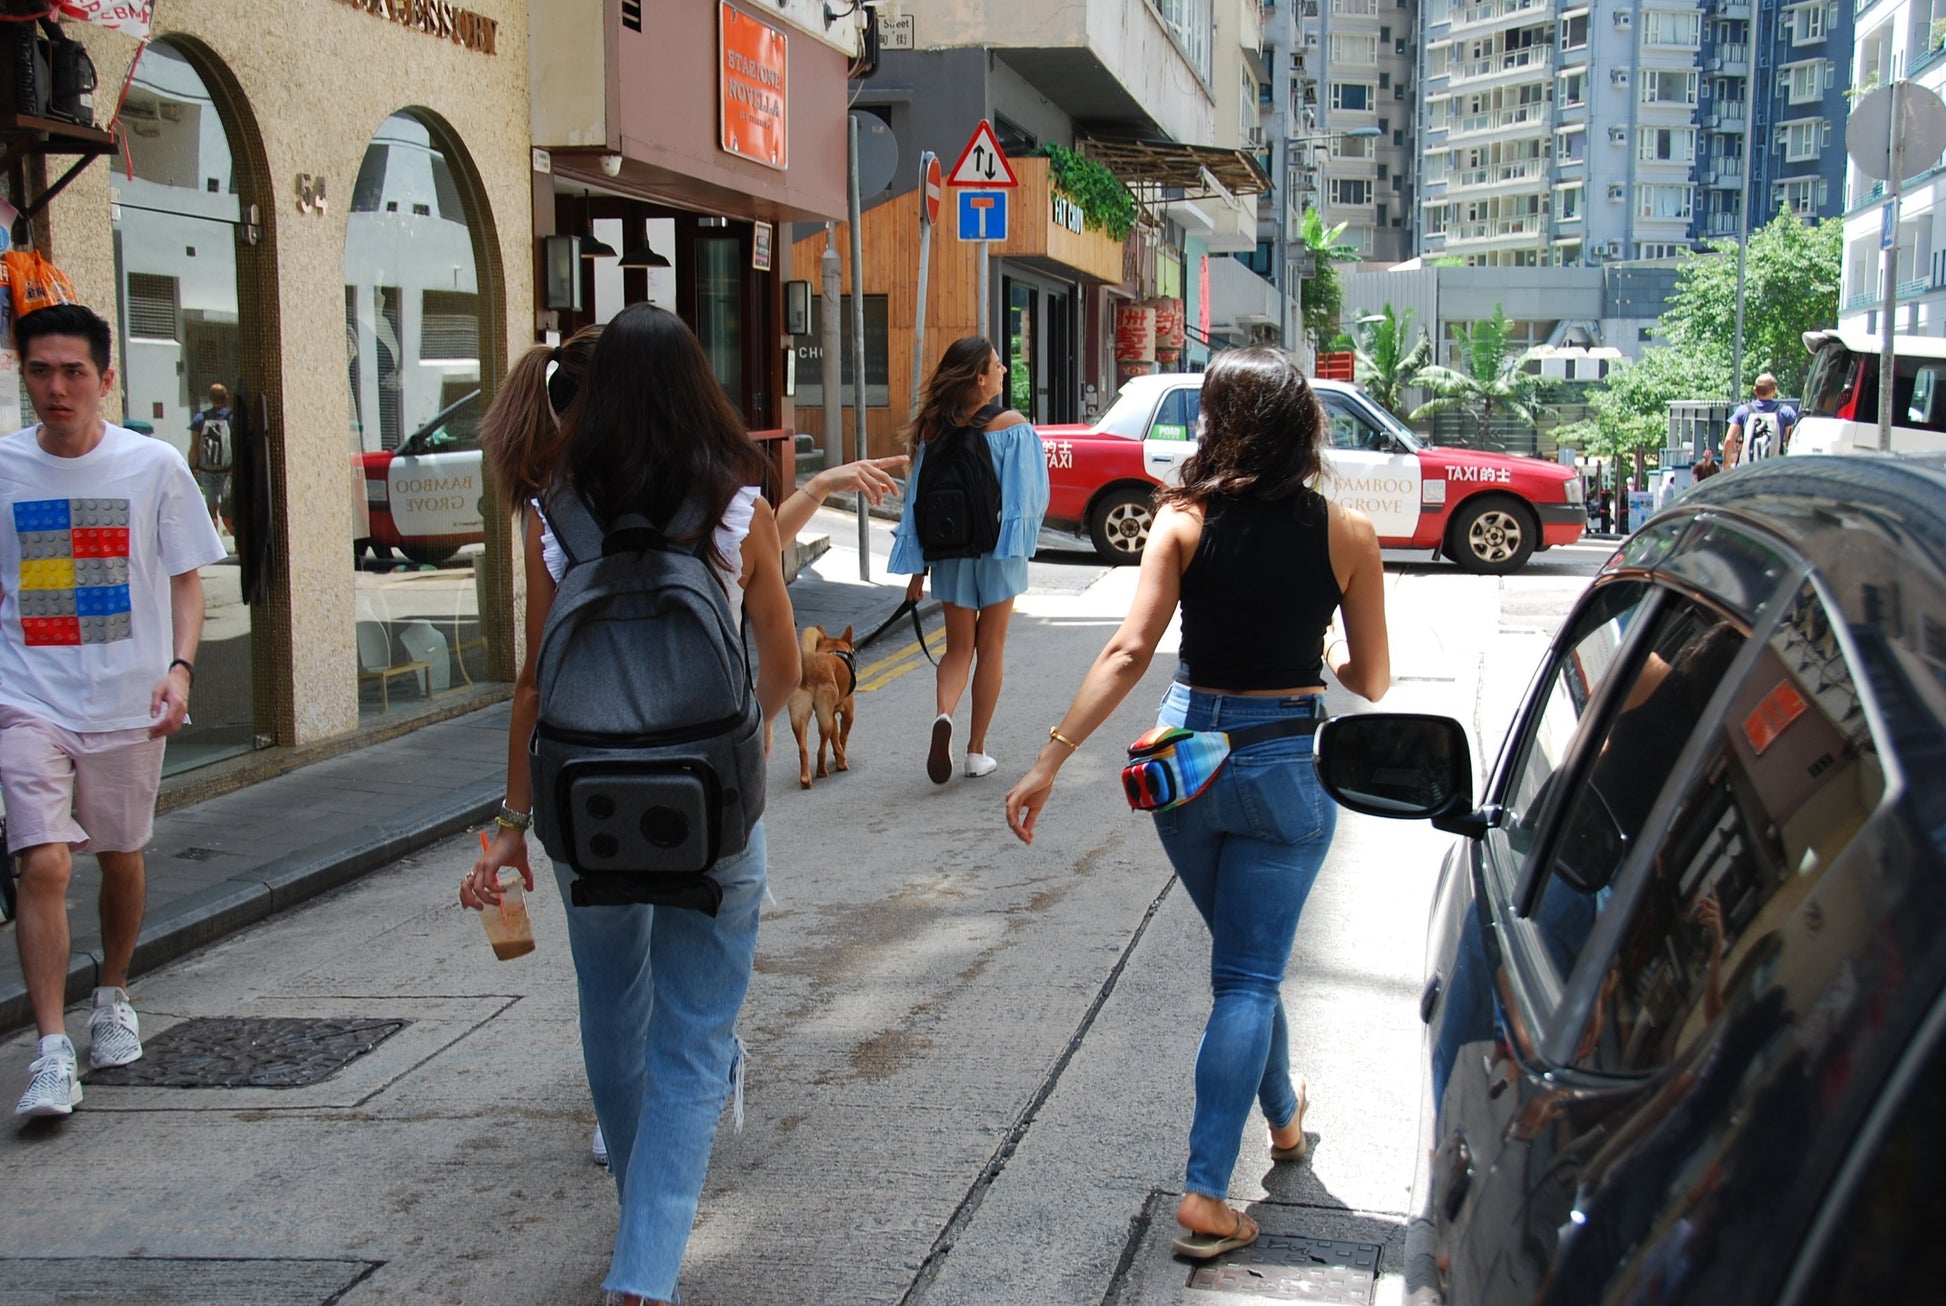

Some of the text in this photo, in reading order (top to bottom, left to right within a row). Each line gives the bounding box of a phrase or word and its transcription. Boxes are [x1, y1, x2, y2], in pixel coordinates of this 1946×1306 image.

[728, 49, 781, 89] STAZIONE
[729, 78, 780, 119] NOVELLA
[295, 173, 328, 217] 54
[1333, 478, 1413, 494] BAMBOO
[1445, 465, 1511, 483] TAXI 的士
[1340, 497, 1403, 513] GROVE
